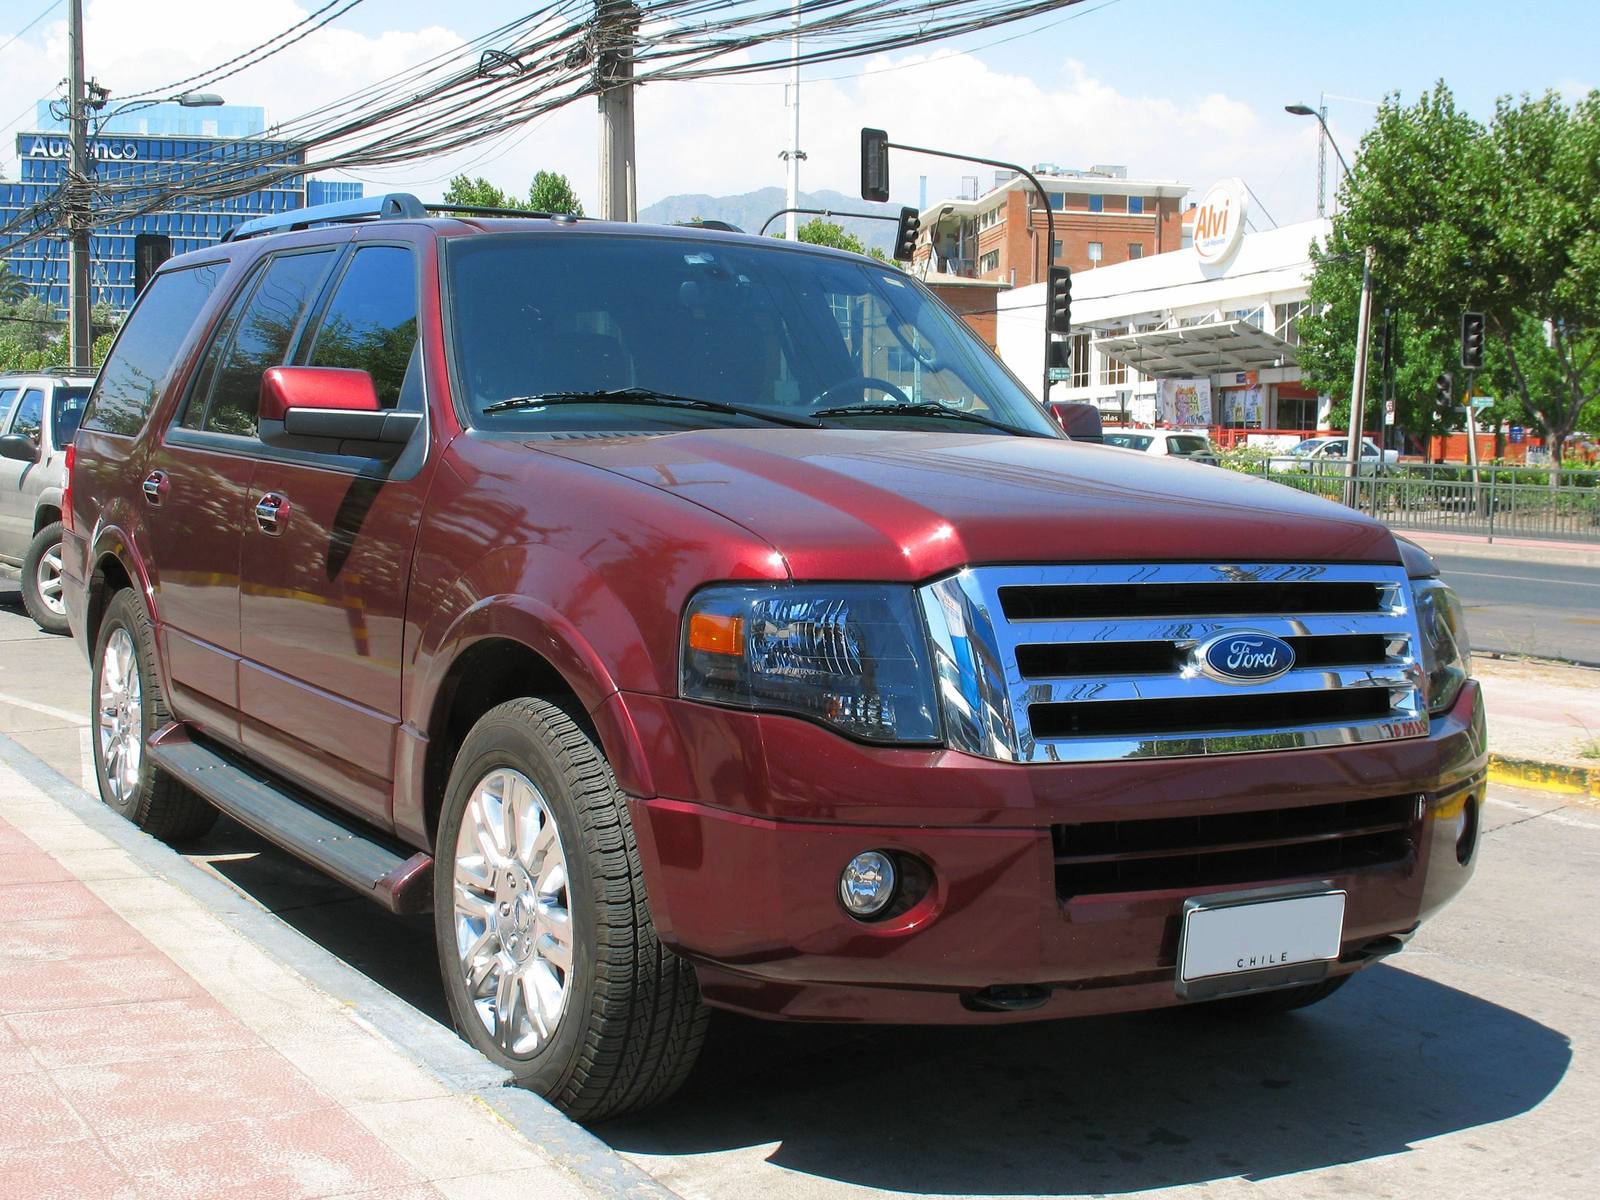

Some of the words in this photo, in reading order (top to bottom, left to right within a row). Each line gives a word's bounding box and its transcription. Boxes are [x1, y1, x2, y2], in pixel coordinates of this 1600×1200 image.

[1194, 199, 1229, 241] Alvi
[1227, 640, 1278, 669] Ford
[1236, 951, 1288, 968] CHILE
